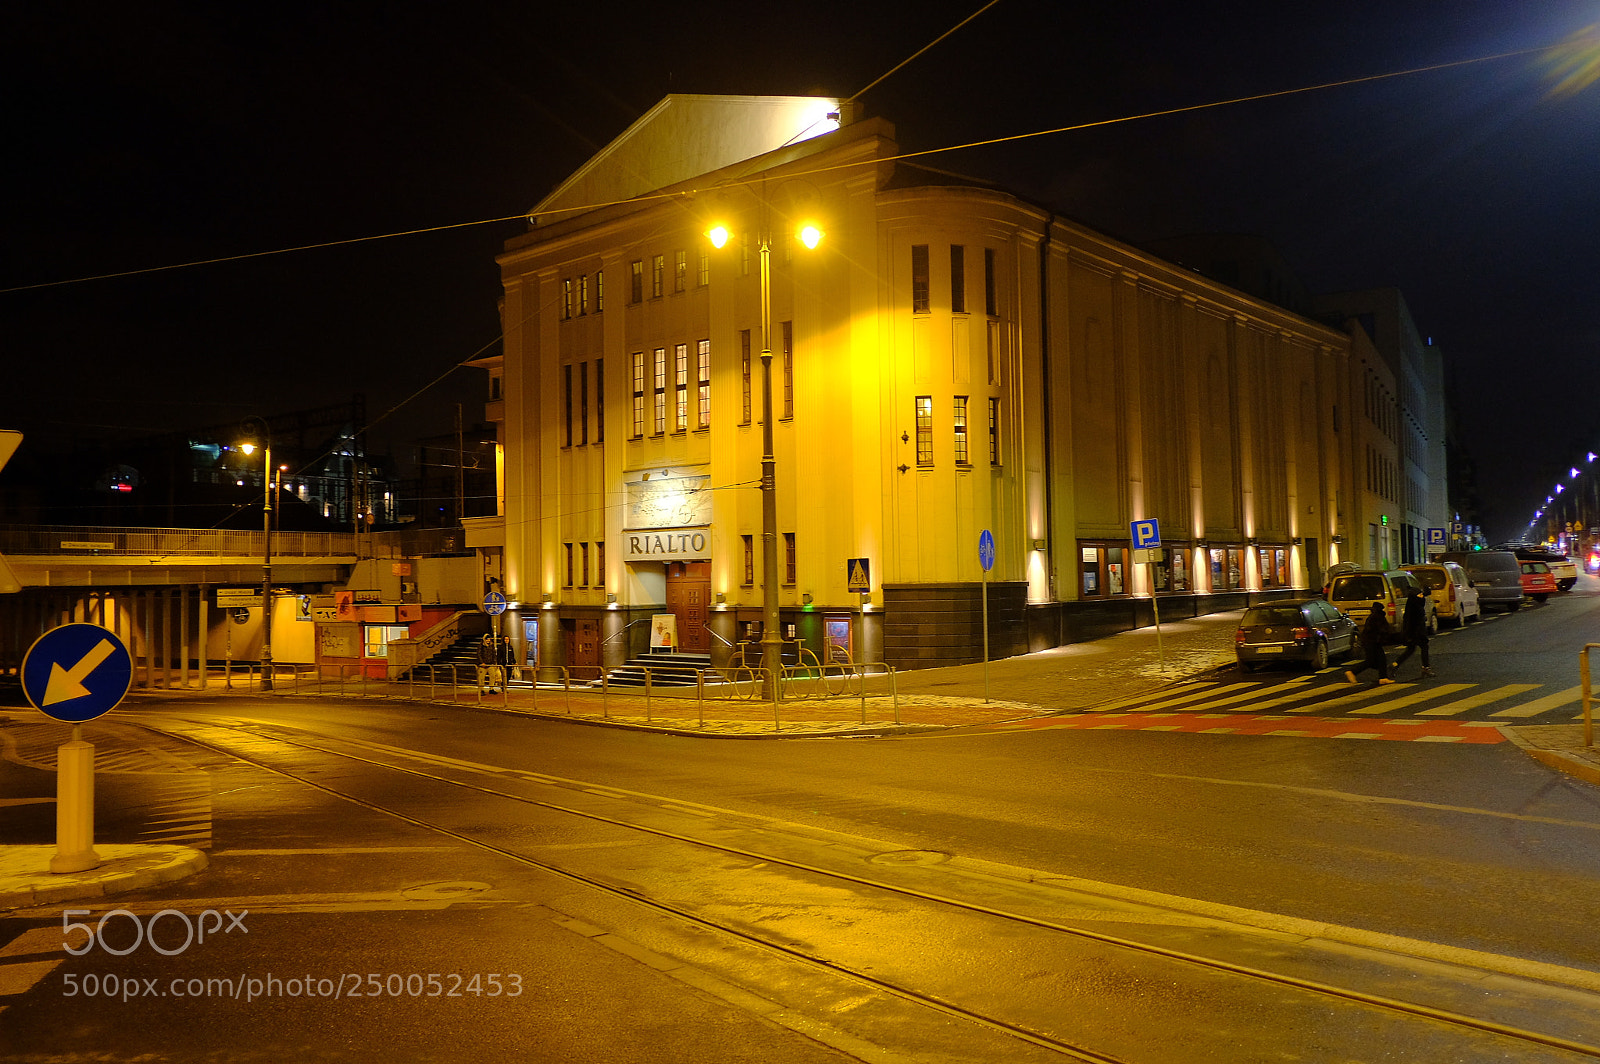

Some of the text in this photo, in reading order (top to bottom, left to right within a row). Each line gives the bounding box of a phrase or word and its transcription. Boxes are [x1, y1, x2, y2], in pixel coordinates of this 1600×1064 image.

[629, 532, 705, 555] RIALTO
[1136, 522, 1154, 546] P
[1431, 529, 1443, 543] P
